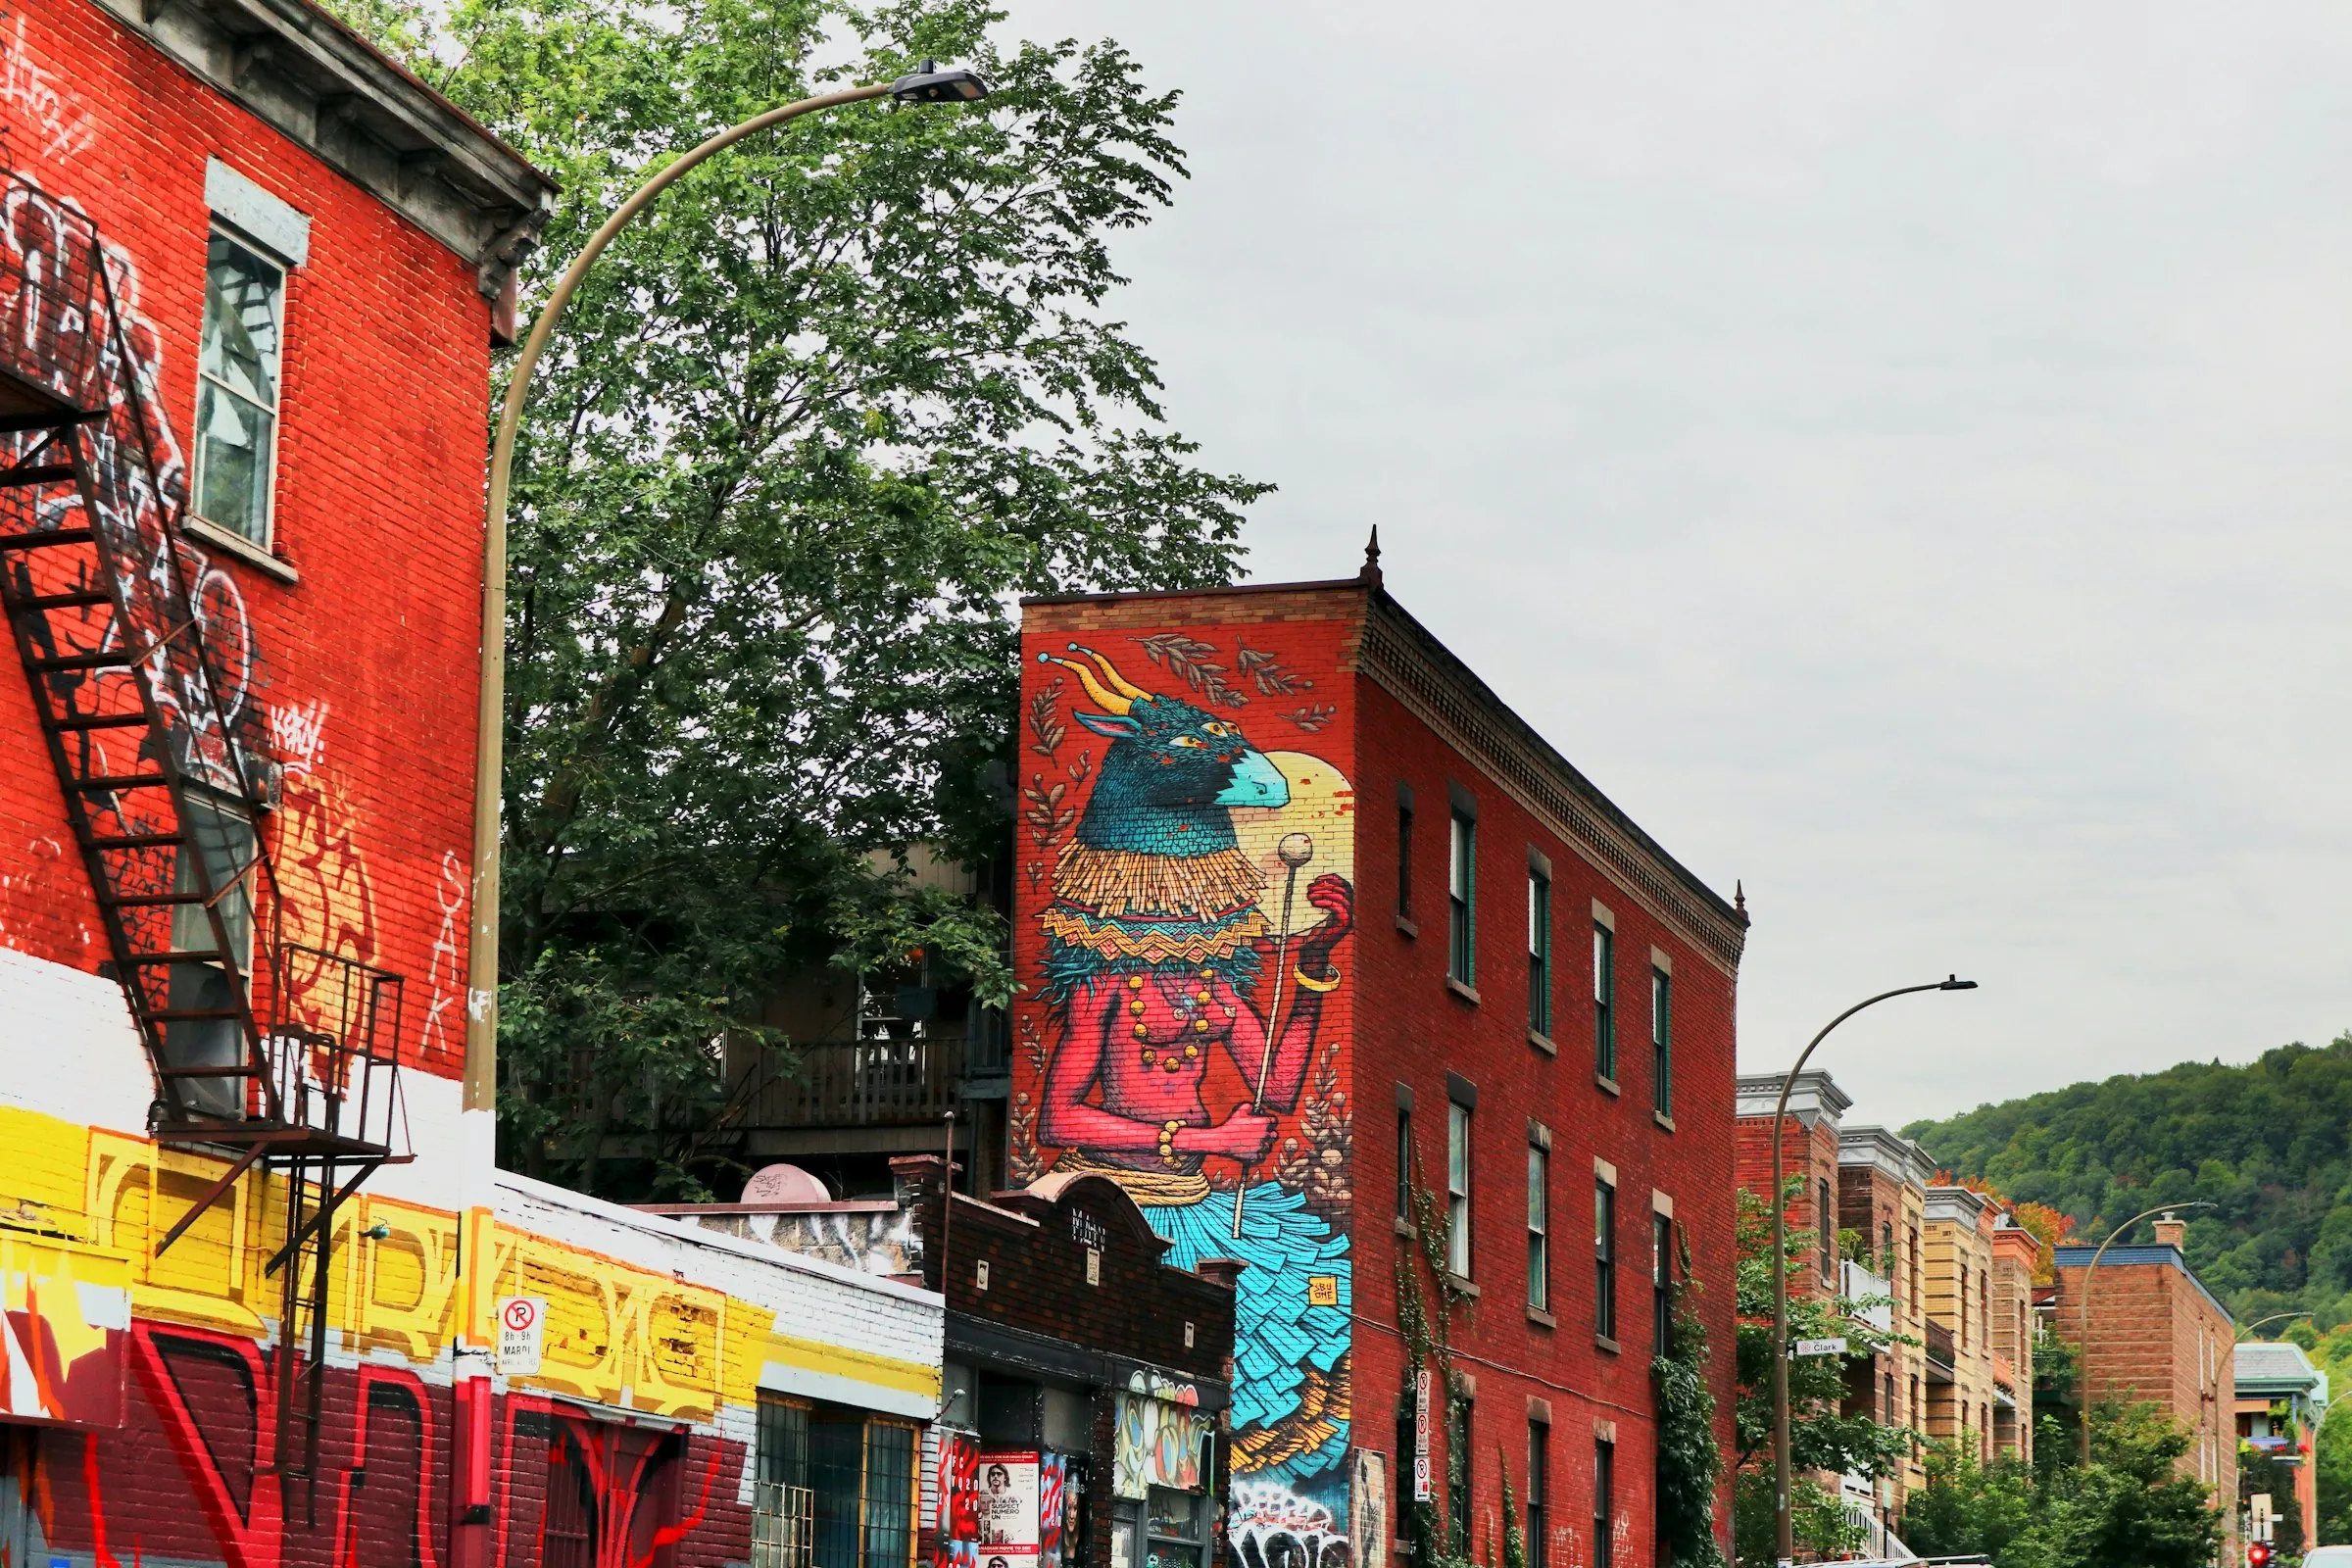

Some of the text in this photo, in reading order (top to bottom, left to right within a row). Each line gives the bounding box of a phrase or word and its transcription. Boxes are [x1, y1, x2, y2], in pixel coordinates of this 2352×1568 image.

[419, 850, 466, 1056] SAK
[1314, 1291, 1333, 1299] ONE
[1813, 1344, 1838, 1352] Clark
